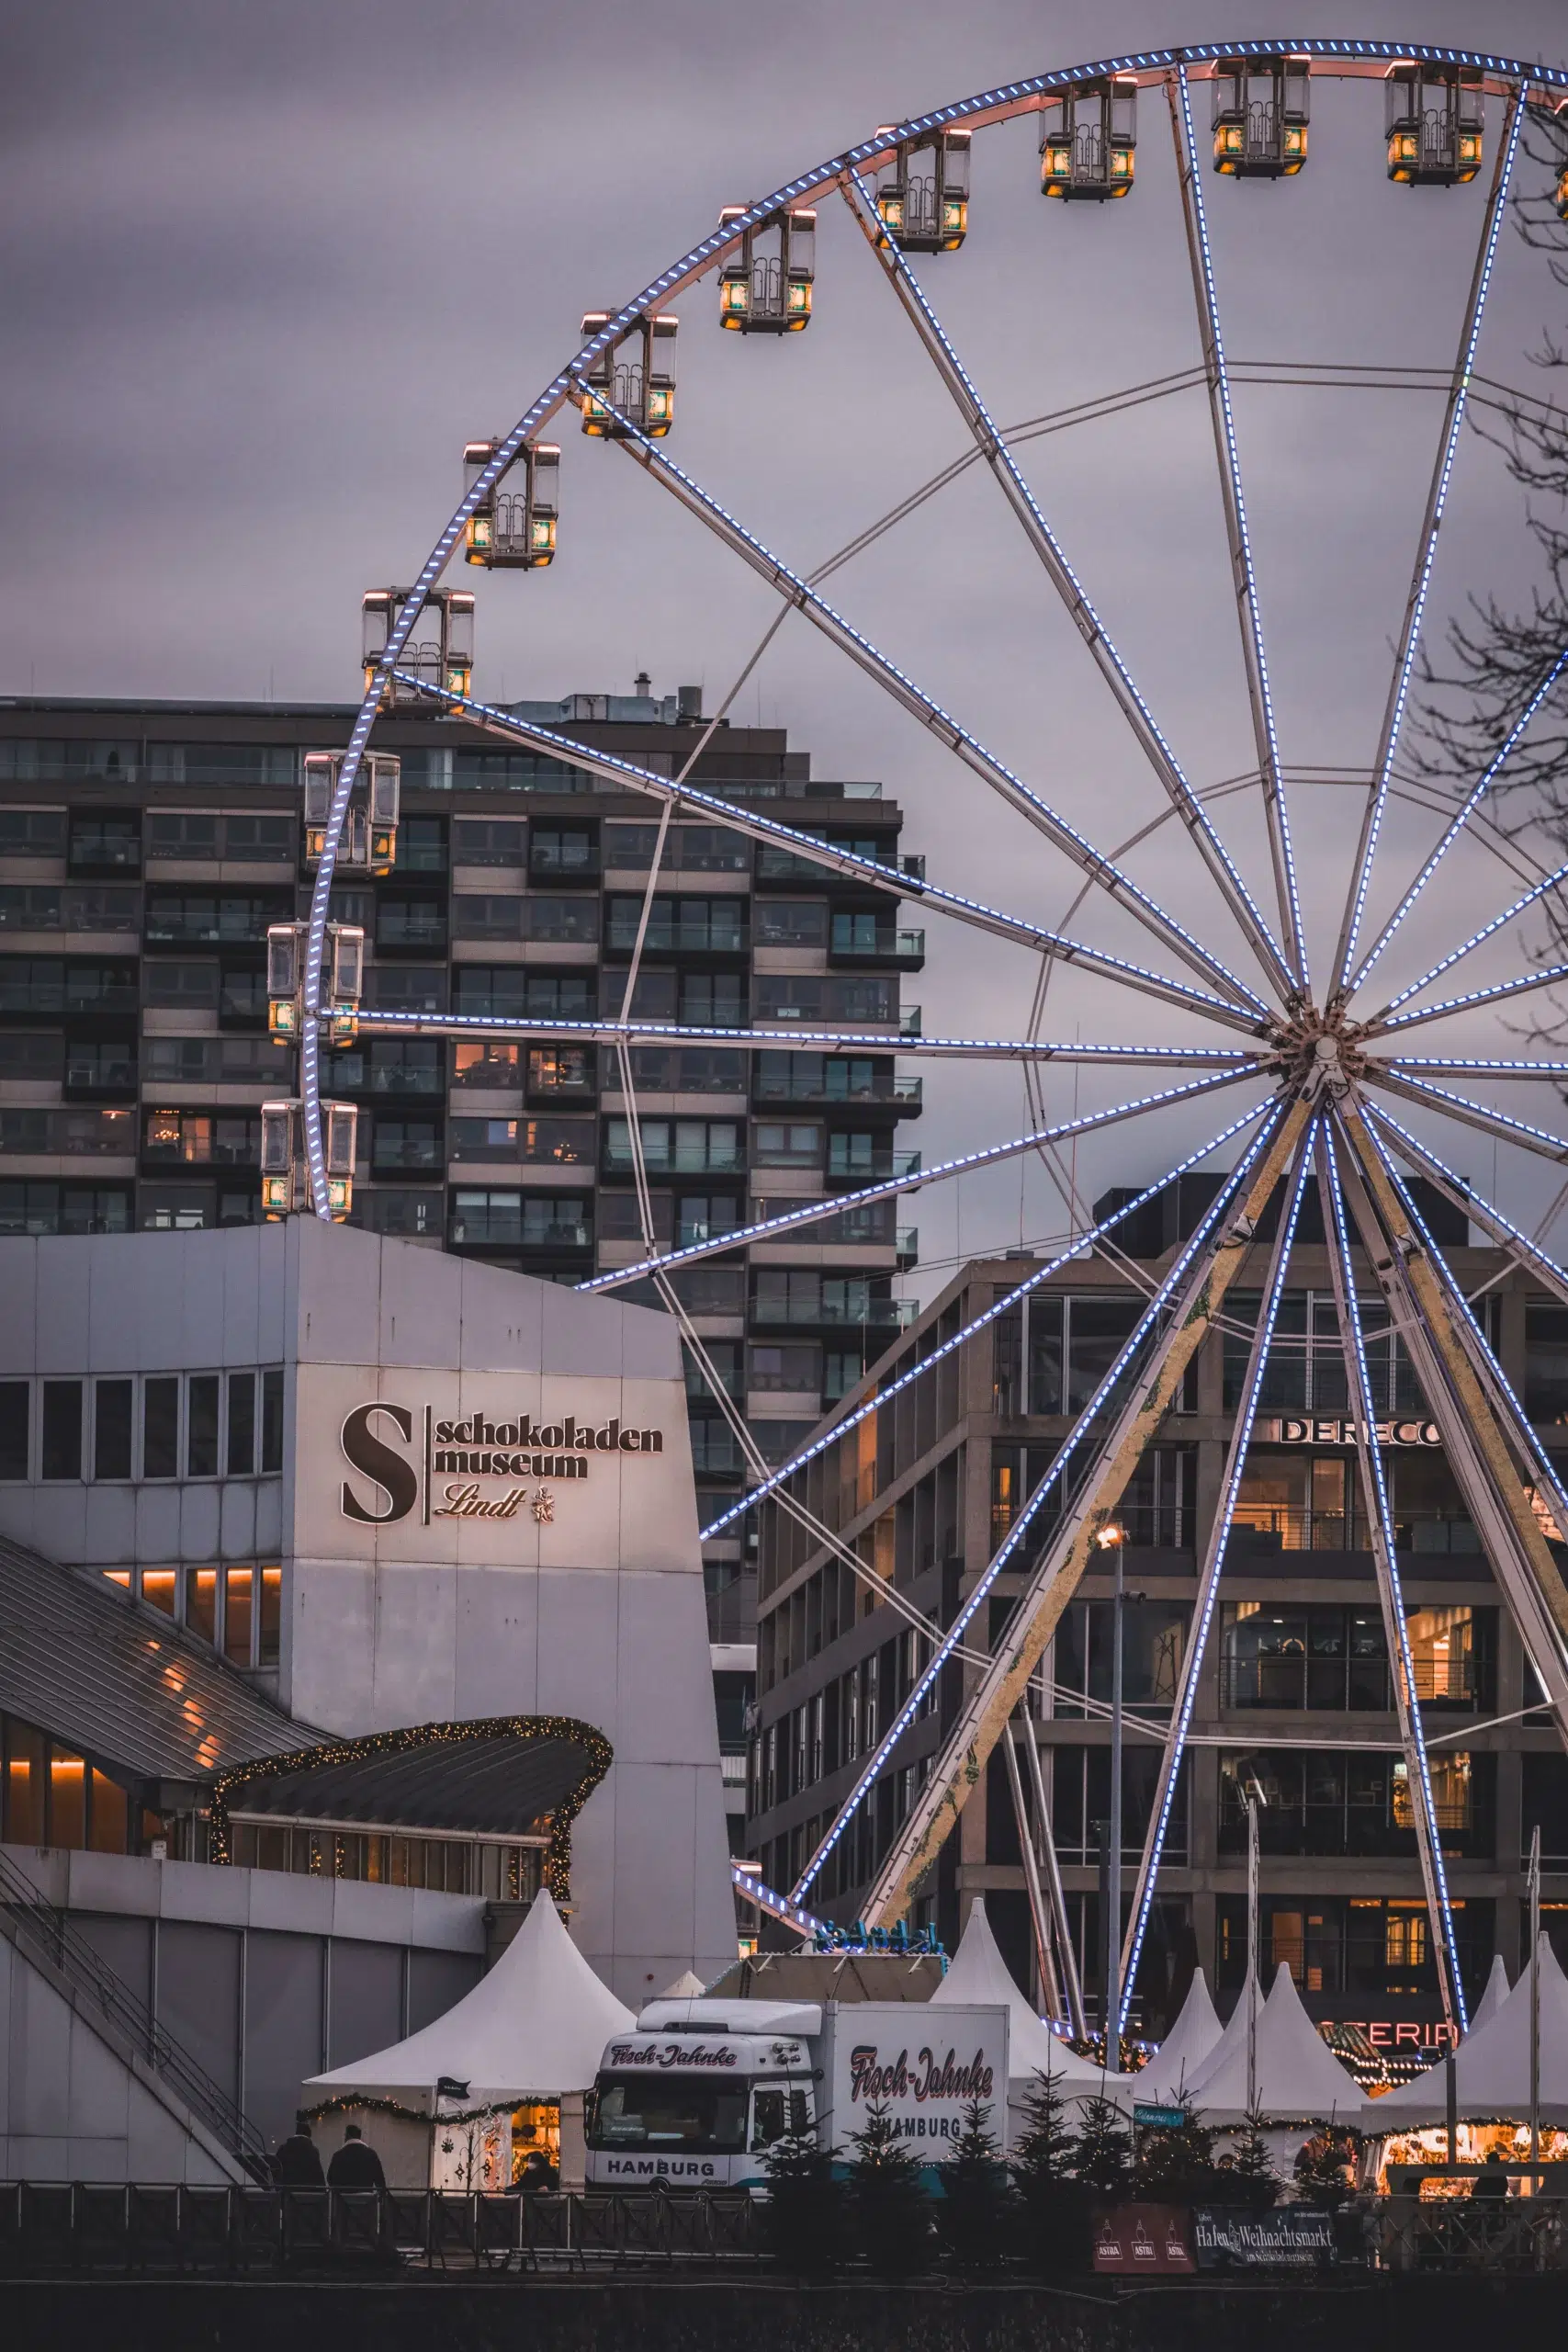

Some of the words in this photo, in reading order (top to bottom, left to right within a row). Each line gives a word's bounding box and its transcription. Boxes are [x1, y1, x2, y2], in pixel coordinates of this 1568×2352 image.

[434, 1411, 663, 1453] schokoladen
[342, 1403, 418, 1525] S
[434, 1449, 589, 1479] museum
[433, 1482, 528, 1519] Lindt
[1321, 2021, 1458, 2046] ERIA
[611, 2043, 738, 2066] Fisch-Jahnke
[851, 2045, 994, 2102] Fisch-Jahnke
[608, 2160, 714, 2177] HAMBURG
[1196, 2224, 1230, 2246] Hafen
[1239, 2224, 1332, 2246] Weihnachtsmarkt
[1100, 2246, 1120, 2256] ASTRA
[1134, 2246, 1154, 2256] ASTRA
[1168, 2246, 1185, 2256] ASTRA
